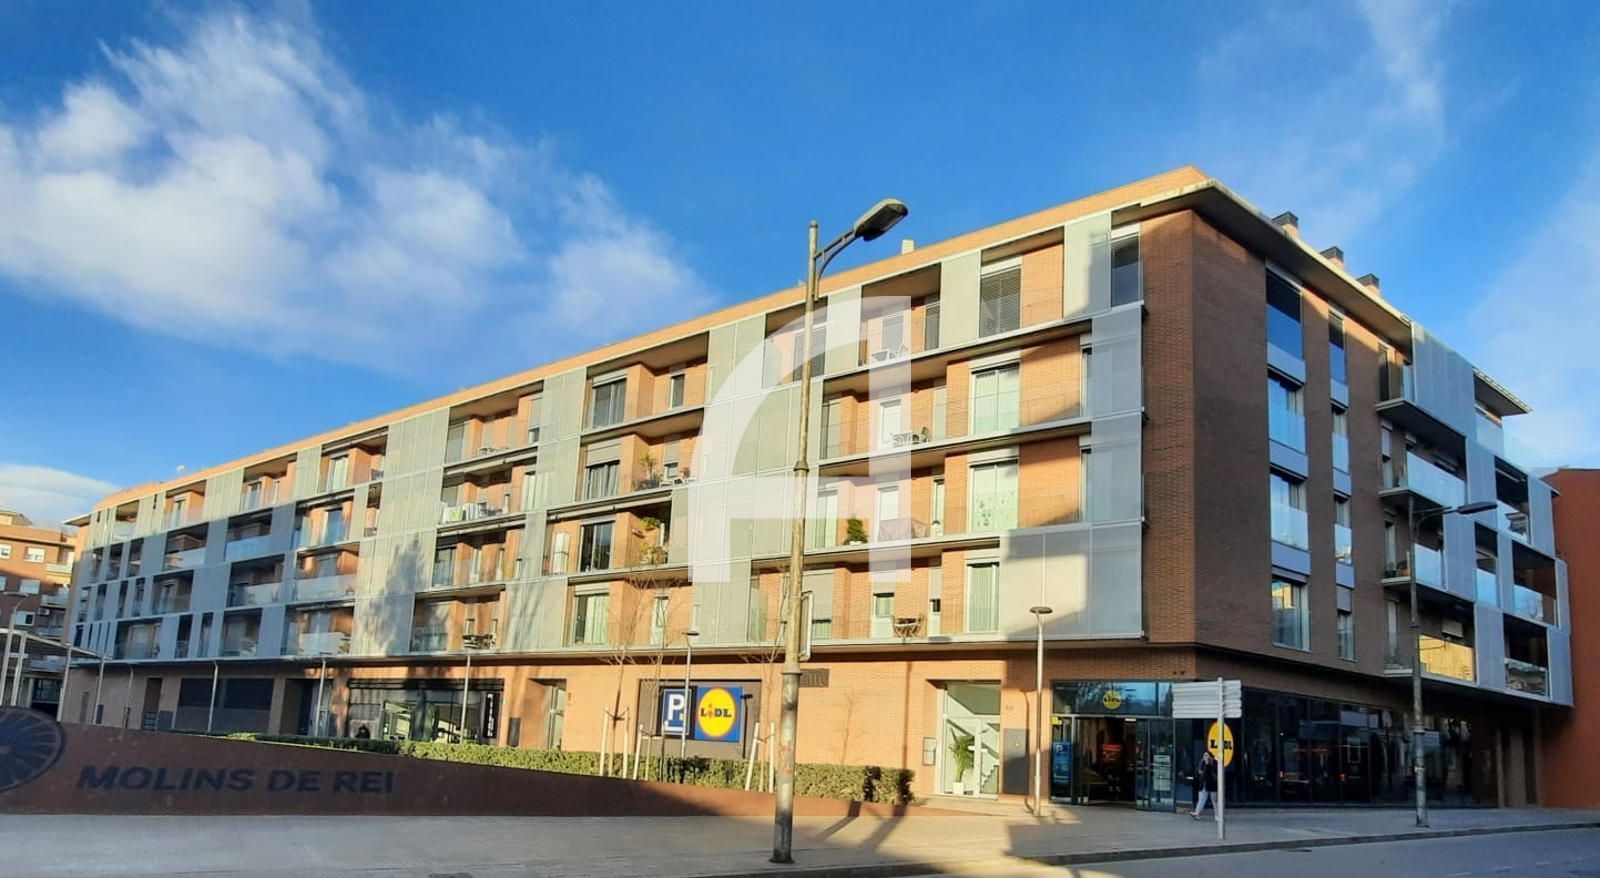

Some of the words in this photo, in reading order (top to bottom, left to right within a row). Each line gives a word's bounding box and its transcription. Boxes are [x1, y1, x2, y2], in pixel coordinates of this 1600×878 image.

[667, 693, 686, 720] P
[1210, 738, 1233, 750] LDL
[77, 765, 255, 792] MOLINS
[266, 769, 321, 792] DE
[332, 770, 395, 793] REI
